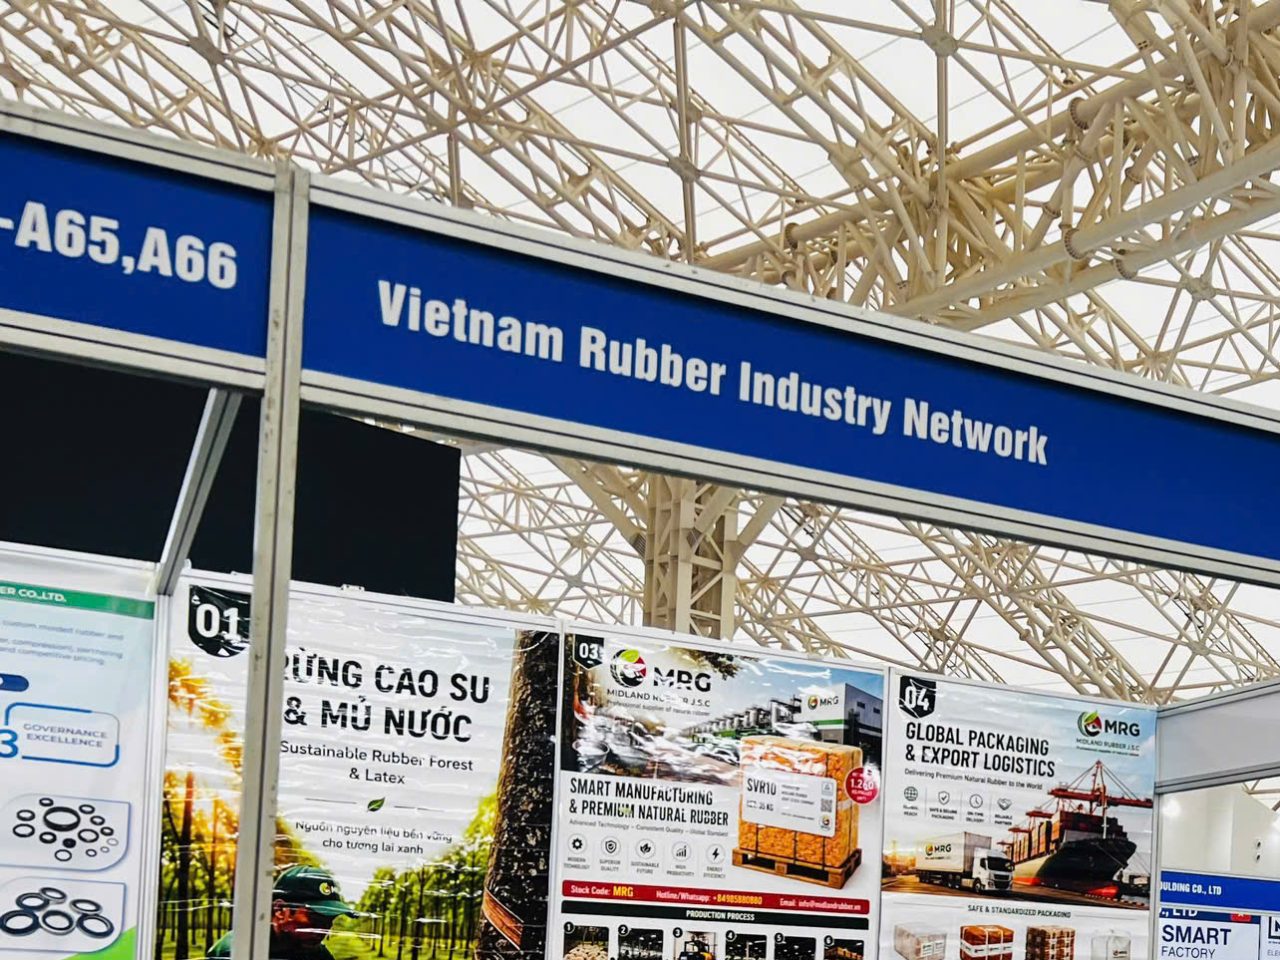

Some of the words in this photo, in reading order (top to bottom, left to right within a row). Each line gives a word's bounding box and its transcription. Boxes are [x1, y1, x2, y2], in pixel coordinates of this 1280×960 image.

[377, 279, 564, 362] Vietnam
[579, 326, 726, 396] Rubber
[739, 361, 892, 435] Industry
[903, 398, 1048, 466] Network
[195, 603, 243, 638] 01
[580, 643, 599, 660] 03
[374, 665, 438, 698] CAO
[450, 672, 490, 703] SU
[653, 667, 711, 692] MRG
[607, 688, 650, 700] MIDLAND
[904, 685, 929, 711] 04
[283, 696, 308, 726] &
[384, 705, 473, 743] NƯỚC
[1104, 720, 1140, 737] MRG
[23, 723, 108, 739] GOVERNANCE
[26, 733, 103, 748] EXCELLENCE
[905, 722, 964, 746] GLOBAL
[968, 730, 1049, 756] PACKAGING
[280, 740, 367, 763] Sustainable
[429, 756, 473, 771] Forest
[904, 744, 916, 762] &
[921, 746, 980, 770] EXPORT
[983, 754, 1056, 778] LOGISTICS
[349, 767, 360, 780] &
[364, 767, 406, 785] Latex
[570, 778, 612, 799] SMART
[615, 782, 713, 806] MANUFACTURING
[569, 798, 577, 814] &
[581, 801, 635, 818] PREMIUM
[638, 804, 687, 824] NATURAL
[690, 808, 729, 826] RUBBER
[322, 837, 343, 850] cho
[381, 840, 394, 853] lai
[397, 842, 424, 855] xanh
[1192, 884, 1207, 895] CO.,
[1208, 885, 1222, 895] LTD
[686, 910, 726, 920] PRODUCTION
[727, 912, 755, 921] PROCESS
[967, 904, 983, 913] SAFE
[991, 907, 1037, 917] STANDARDIZED
[1037, 910, 1071, 919] PACKAGING
[1161, 924, 1232, 946] SMART
[1161, 946, 1216, 959] FACTORY
